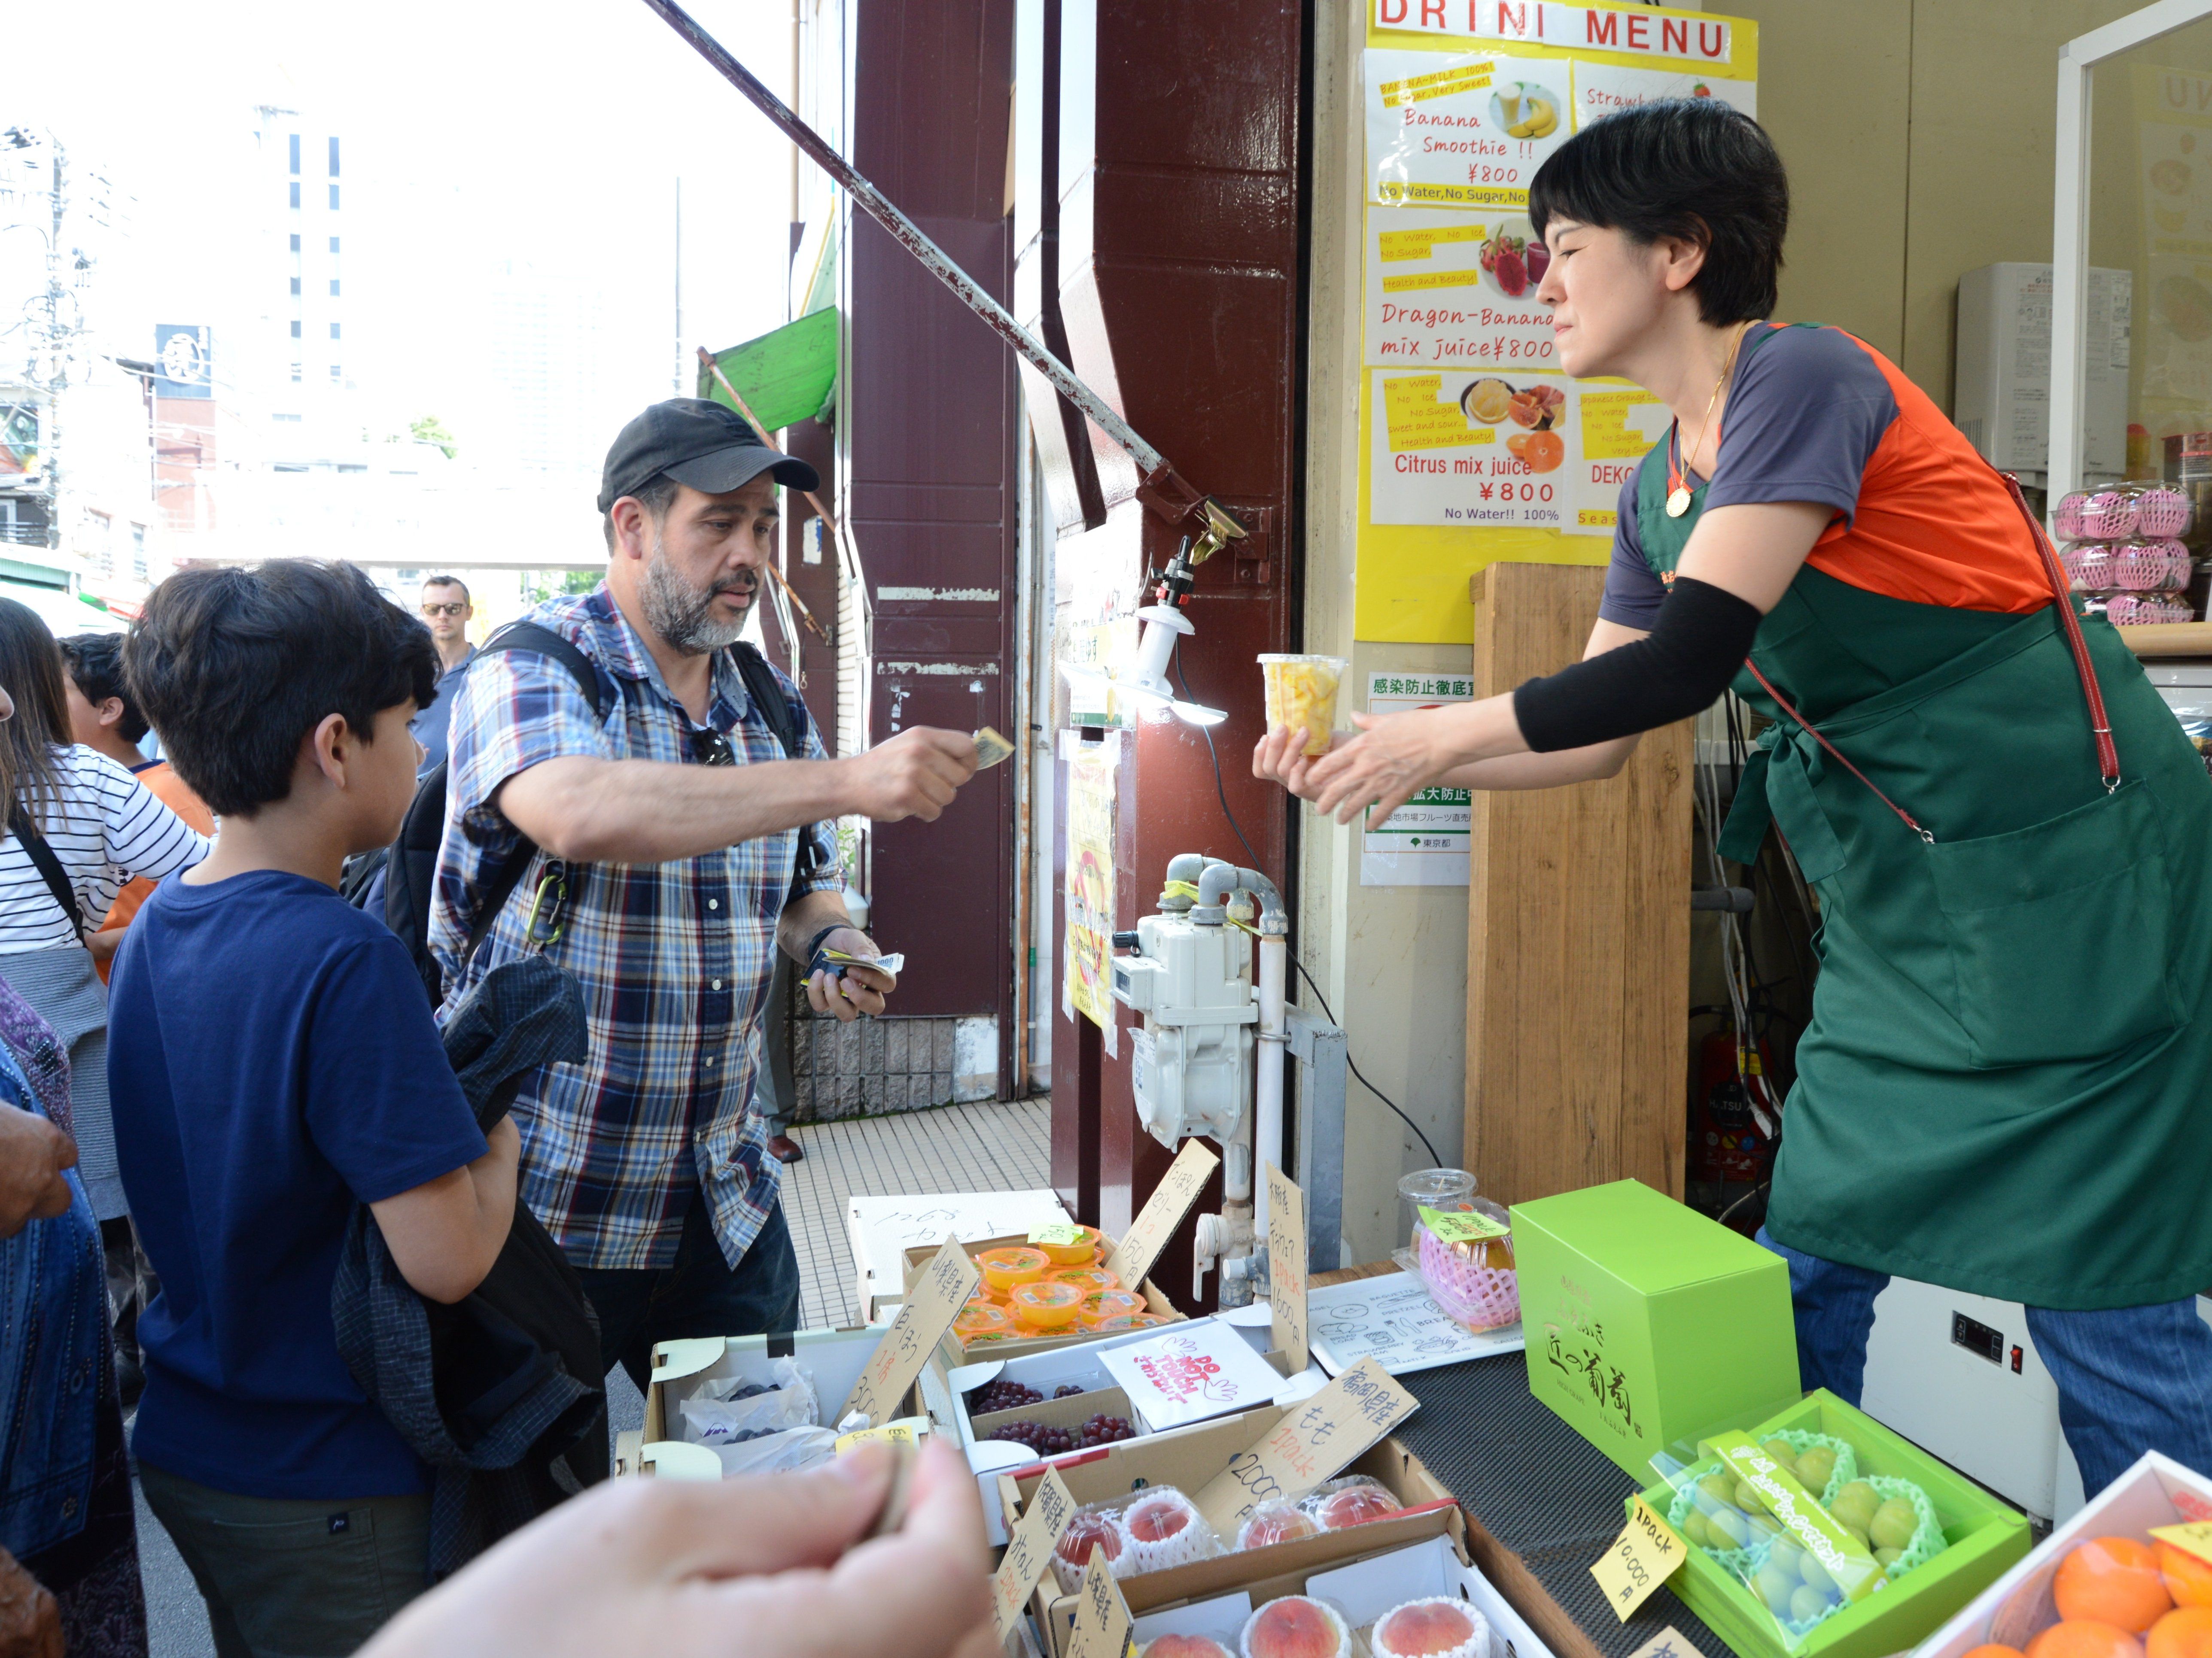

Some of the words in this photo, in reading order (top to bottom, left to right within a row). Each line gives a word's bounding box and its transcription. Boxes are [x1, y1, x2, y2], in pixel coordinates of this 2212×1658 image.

[1381, 0, 1543, 37] DRIN
[1586, 9, 1722, 58] MENU
[1384, 97, 1396, 106] No
[1404, 108, 1481, 128] Banana
[1423, 136, 1507, 156] Smoothie
[1468, 163, 1518, 184] ¥800
[1379, 185, 1397, 197] No
[1404, 232, 1436, 242] Water,
[1396, 248, 1431, 258] Sugar,
[1383, 277, 1415, 289] Health
[1418, 276, 1436, 285] and
[1439, 272, 1477, 285] Beauty!
[1381, 337, 1419, 355] mix
[1409, 379, 1441, 388] Water,
[1422, 394, 1436, 402] Ice,
[1578, 396, 1614, 407] Japanese
[1616, 394, 1646, 403] Orange
[1426, 407, 1460, 417] Sugar,
[1387, 424, 1413, 433] sweet
[1416, 420, 1435, 431] and
[1401, 437, 1433, 447] Health
[1436, 434, 1454, 444] and
[1456, 431, 1495, 444] Beauty!
[1615, 434, 1643, 443] Sugar,
[1395, 454, 1447, 474] Citrus
[1454, 456, 1483, 475] mix
[1491, 456, 1532, 477] juice
[1479, 482, 1554, 502] ¥800
[1445, 508, 1461, 519] No
[1467, 508, 1514, 520] Water!!
[1524, 509, 1559, 521] 100%
[1387, 813, 1472, 822] 地市場フルーツ直売
[1423, 838, 1451, 848] 東京都
[877, 957, 894, 966] 1000
[1121, 1235, 1144, 1265] 150
[1125, 1266, 1138, 1282] 円
[1369, 1289, 1416, 1301] BAGUETTE
[1272, 1285, 1294, 1325] 1600
[1381, 1304, 1422, 1316] PRETZEL
[1347, 1342, 1404, 1357] STRAWBERRY
[1175, 1355, 1210, 1382] NOT
[1194, 1355, 1220, 1373] DO
[1155, 1354, 1199, 1395] TOUCH
[1543, 1322, 1631, 1427] 匠の葡萄
[1341, 1365, 1400, 1427] 福岡県産
[1299, 1406, 1336, 1445] もも
